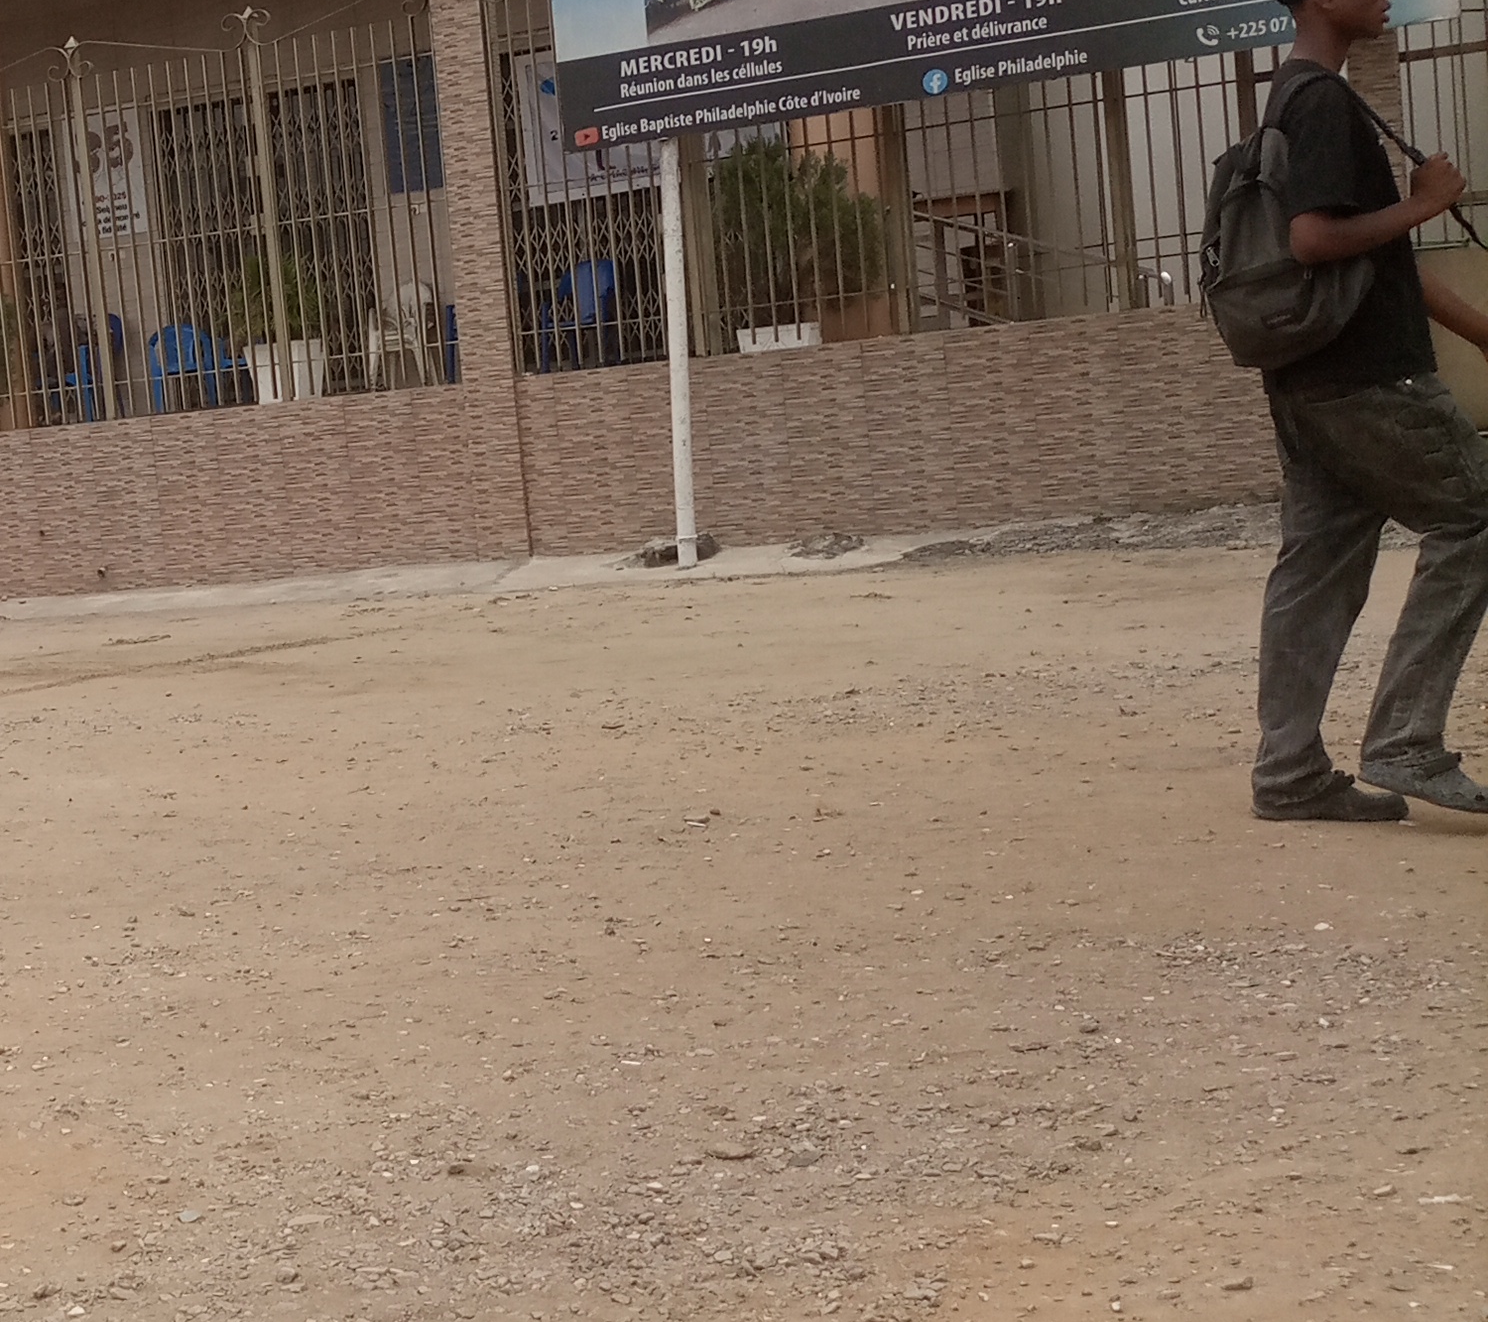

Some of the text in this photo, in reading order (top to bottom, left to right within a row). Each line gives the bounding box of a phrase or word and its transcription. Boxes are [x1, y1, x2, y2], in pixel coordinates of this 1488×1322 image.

[907, 16, 1048, 51] Prière et délivrance
[1226, 20, 1267, 40] +225
[1270, 16, 1289, 33] 07
[620, 44, 722, 77] MERCREDI
[740, 36, 778, 57] 19h
[954, 49, 1088, 86] Eglise Philadelphie
[620, 59, 783, 99] Réunion dans les céllules
[601, 87, 861, 142] Eglise Baptiste Philadelphie Côte d'Ivoire
